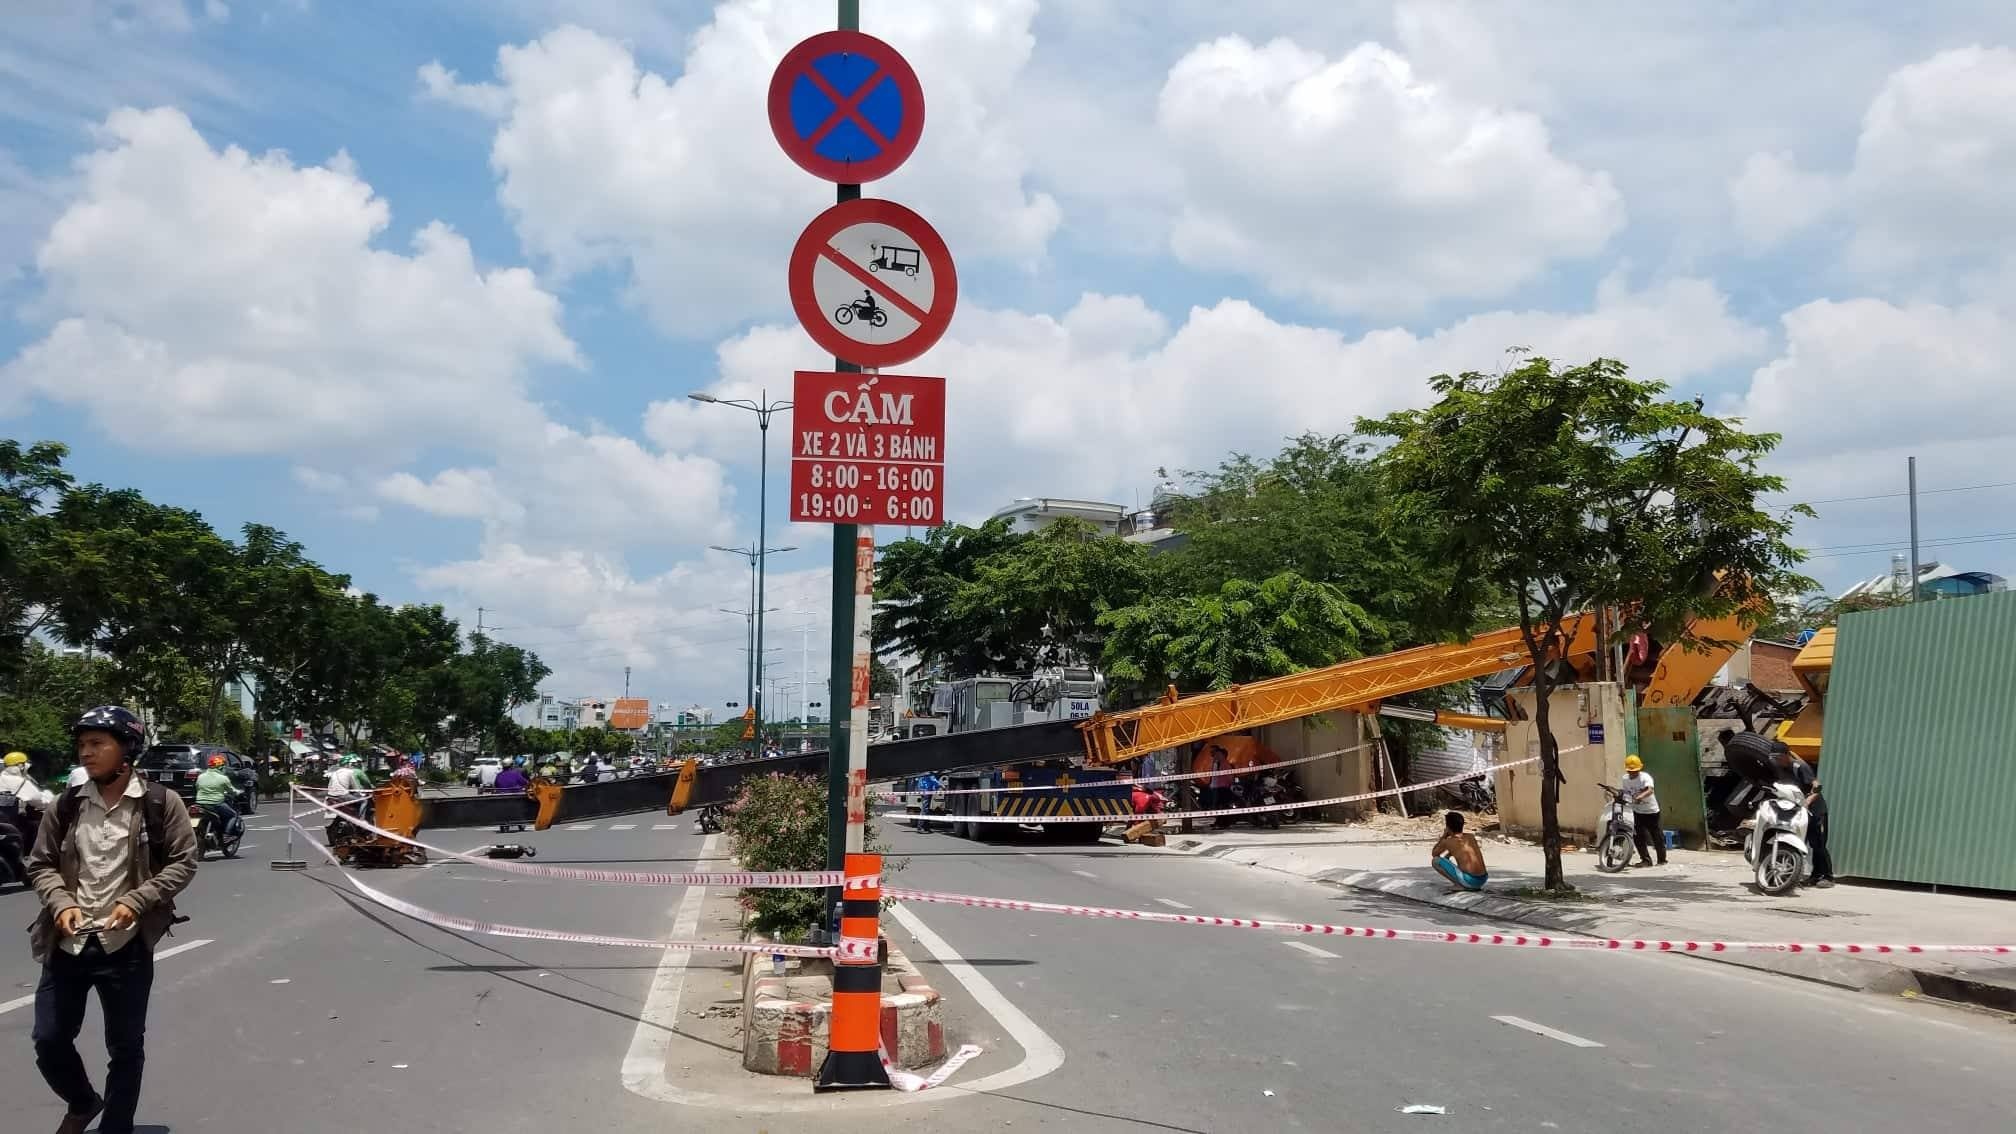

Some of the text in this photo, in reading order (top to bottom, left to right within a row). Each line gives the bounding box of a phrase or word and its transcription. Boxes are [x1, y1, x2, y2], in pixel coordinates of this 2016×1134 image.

[824, 376, 914, 426] CẤM
[802, 426, 936, 460] XE 2 VÀ 3 BÁNH
[811, 464, 859, 489] 8:00
[877, 466, 934, 492] 16:00
[800, 493, 859, 518] 19:00
[887, 495, 934, 520] 6:00
